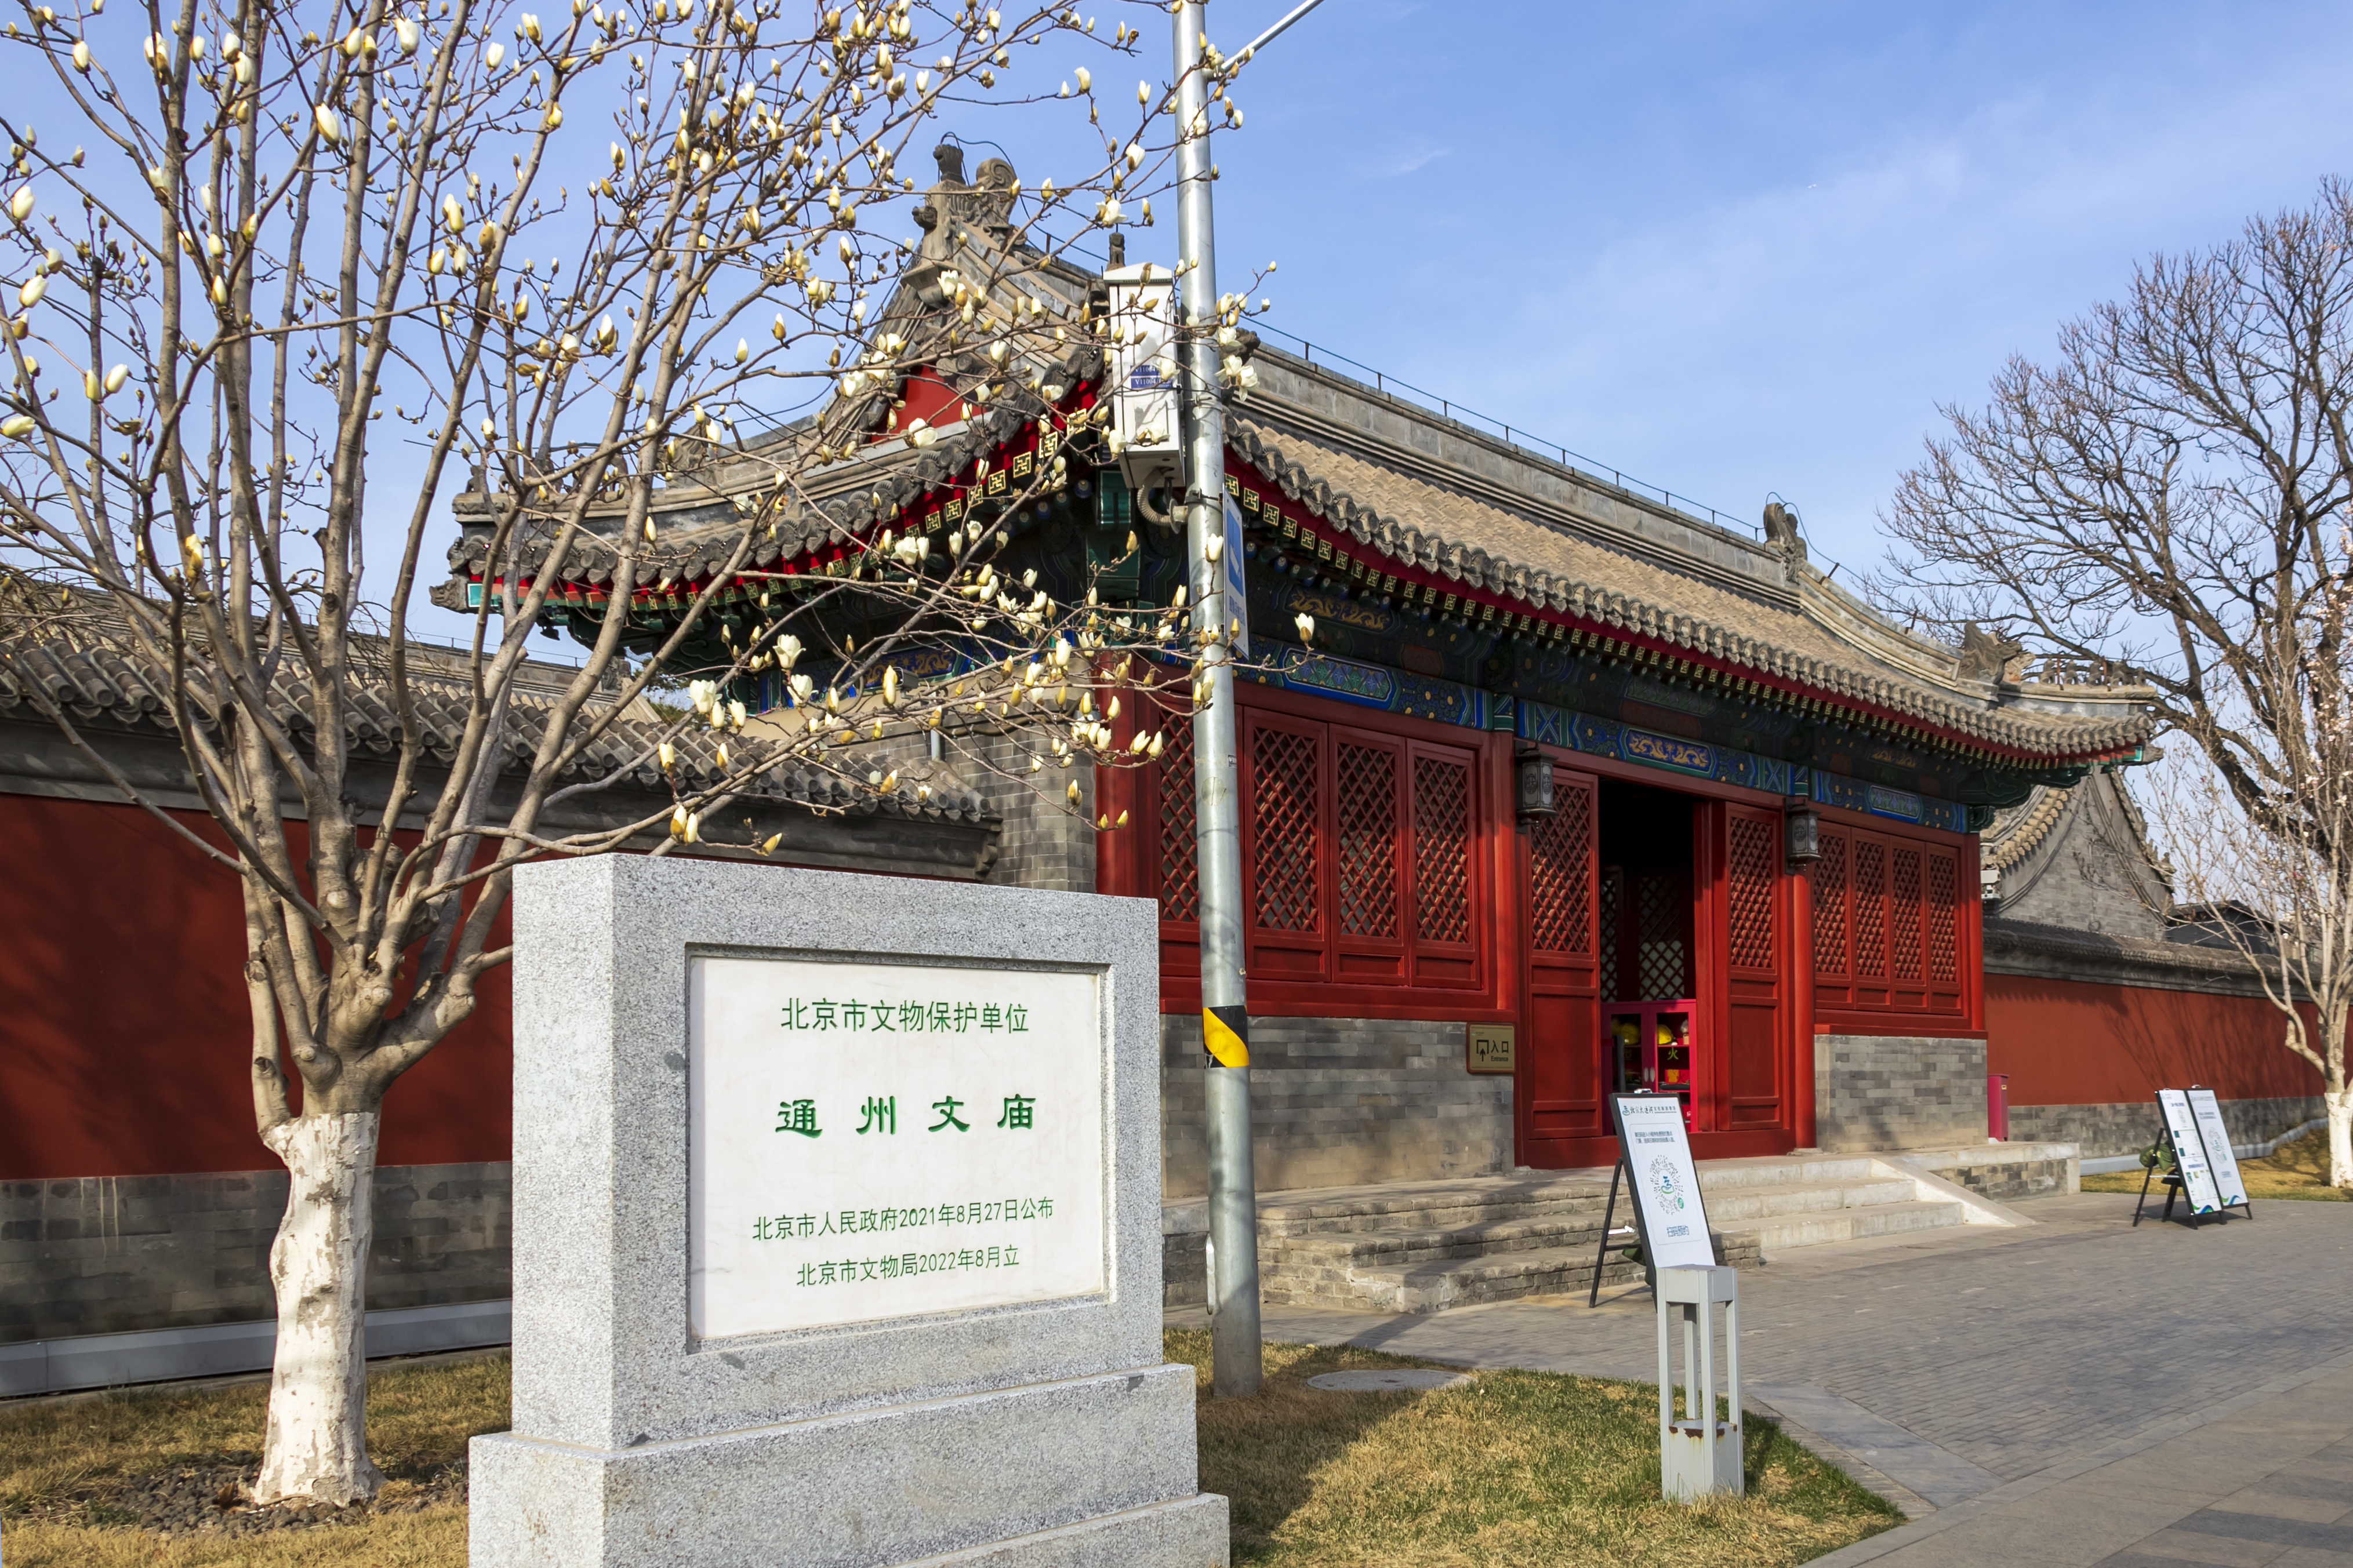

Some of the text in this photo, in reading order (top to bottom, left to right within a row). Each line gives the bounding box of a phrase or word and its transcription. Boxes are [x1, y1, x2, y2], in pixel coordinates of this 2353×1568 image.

[782, 998, 1029, 1033] 北京市文物保护单位
[1491, 1040, 1509, 1053] 入口
[775, 1094, 1036, 1138] 通州文庙
[753, 1196, 1054, 1240] 北京市人民政府2021年8月27日公布
[797, 1244, 1019, 1286] 北京市文物局2022年8月立
